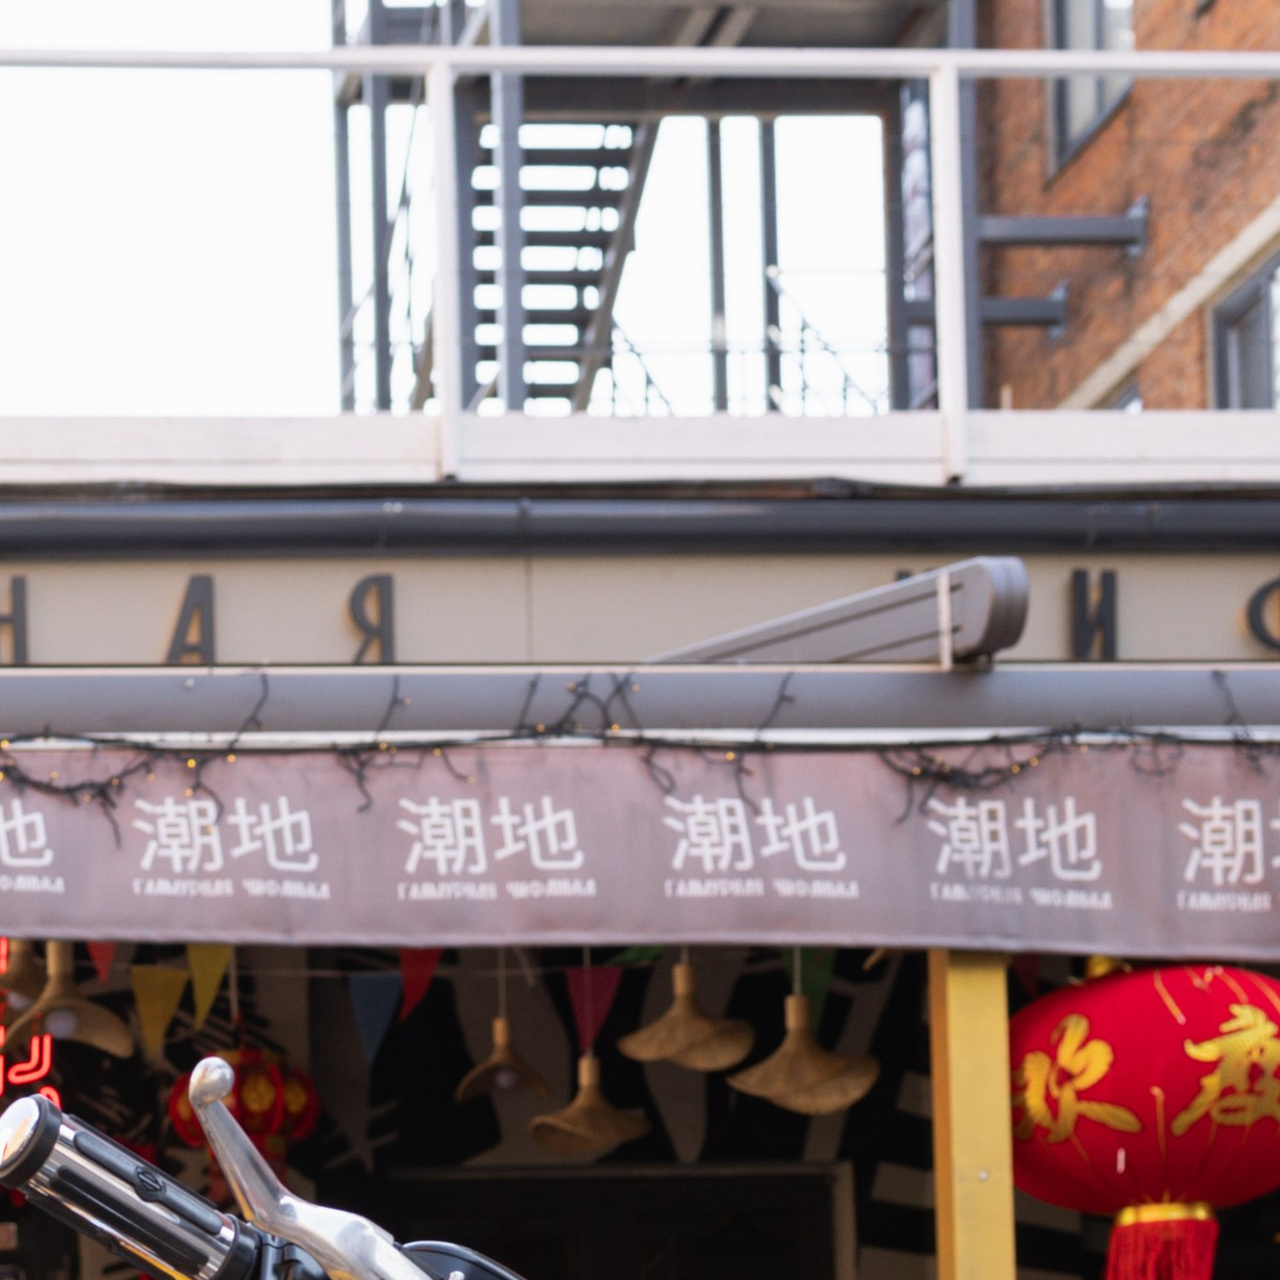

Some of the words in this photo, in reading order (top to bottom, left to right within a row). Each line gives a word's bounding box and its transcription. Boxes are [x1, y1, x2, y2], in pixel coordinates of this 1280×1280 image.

[132, 797, 317, 871] 潮地
[397, 797, 583, 873] 潮地
[663, 796, 845, 870] 潮地
[927, 798, 1102, 882] 潮地
[1177, 797, 1280, 886] 潮
